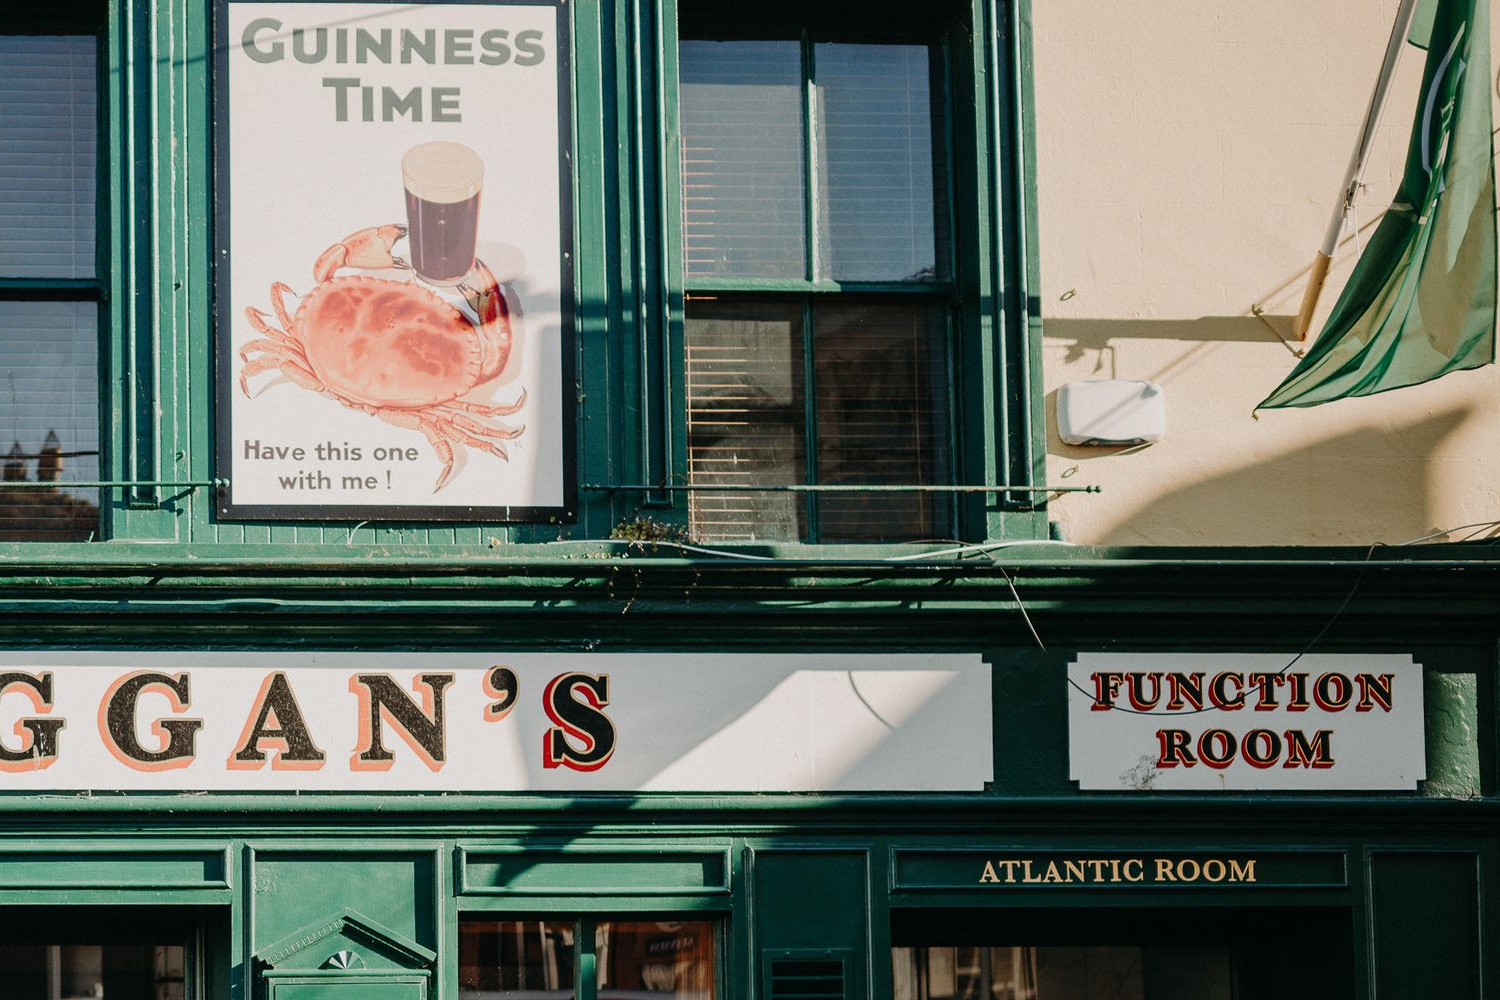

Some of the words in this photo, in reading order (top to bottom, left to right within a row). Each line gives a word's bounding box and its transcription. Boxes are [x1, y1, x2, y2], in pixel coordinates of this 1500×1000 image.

[241, 17, 546, 66] GUINNESS
[322, 77, 463, 123] TIME
[243, 439, 306, 462] Have
[314, 442, 363, 463] this
[373, 447, 420, 463] one
[278, 469, 332, 491] with
[1090, 671, 1396, 713] FUNCTION
[1156, 728, 1336, 769] ROOM
[978, 859, 1145, 884] ATLANTIC
[1153, 858, 1258, 883] ROOM
